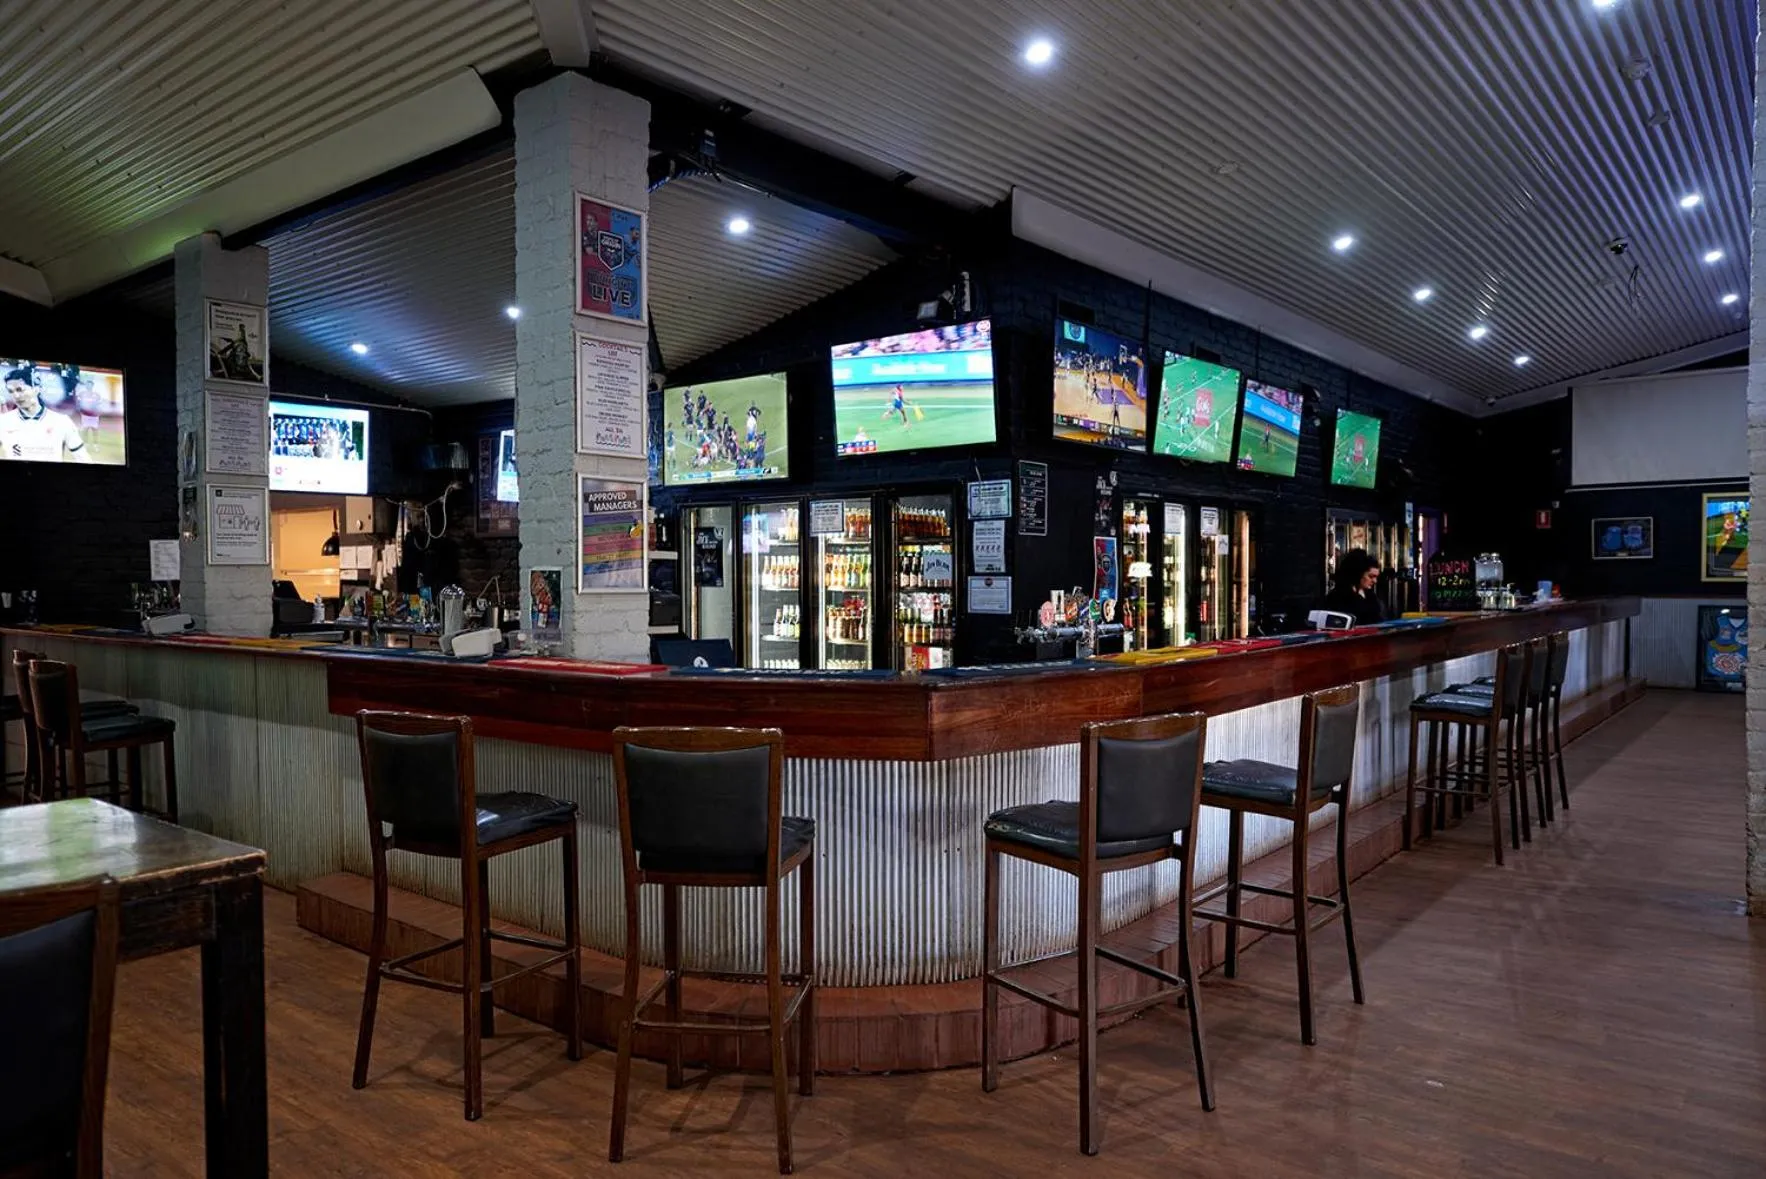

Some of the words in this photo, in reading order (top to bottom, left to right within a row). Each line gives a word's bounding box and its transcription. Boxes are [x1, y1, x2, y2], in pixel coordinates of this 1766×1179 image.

[591, 282, 632, 308] LIVE
[588, 491, 628, 502] APPROVED
[593, 501, 638, 512] MANAGERS
[1430, 560, 1470, 576] LUNCH
